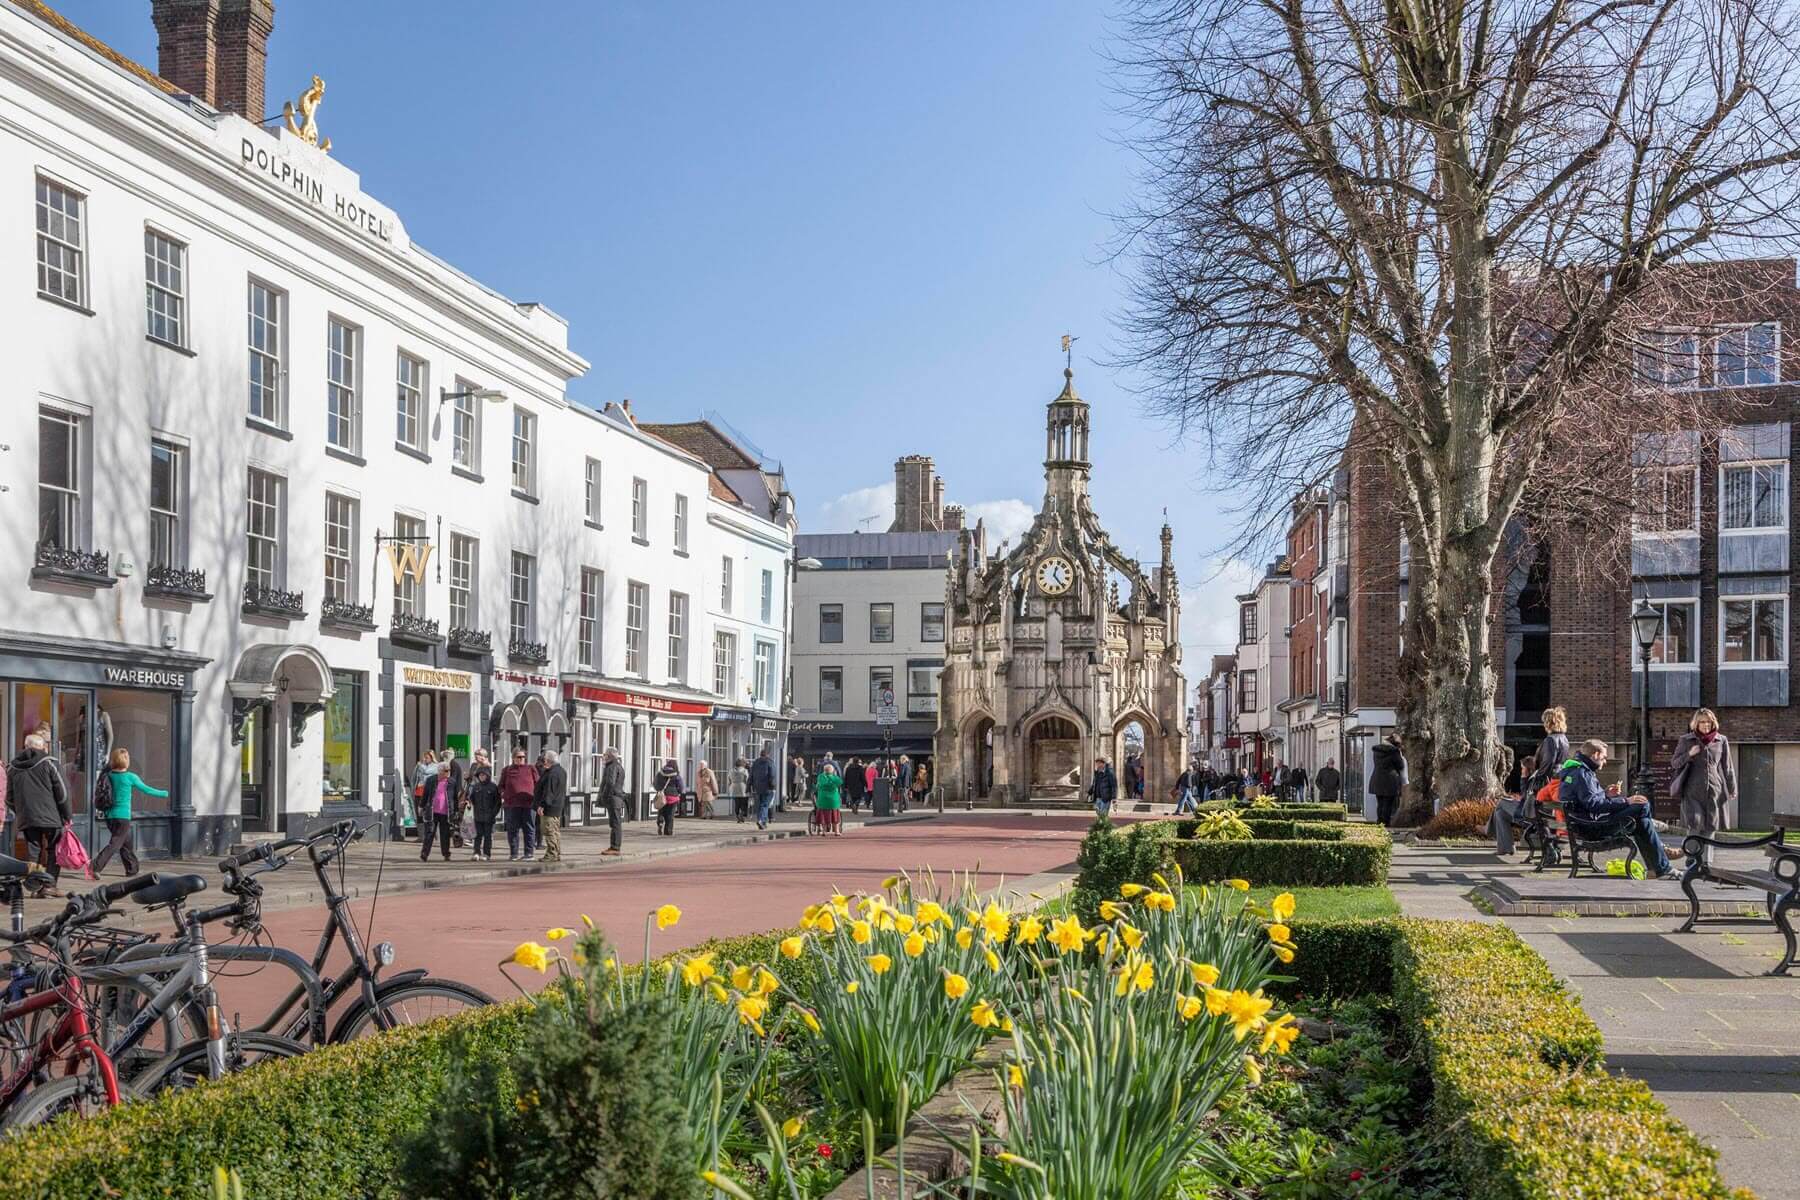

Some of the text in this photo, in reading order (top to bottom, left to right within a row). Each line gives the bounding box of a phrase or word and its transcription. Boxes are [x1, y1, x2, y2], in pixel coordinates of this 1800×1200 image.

[241, 138, 388, 242] DOLPHIN HOTEL
[384, 543, 433, 586] W
[106, 667, 185, 686] WAREHOUSE
[812, 722, 834, 730] Arts
